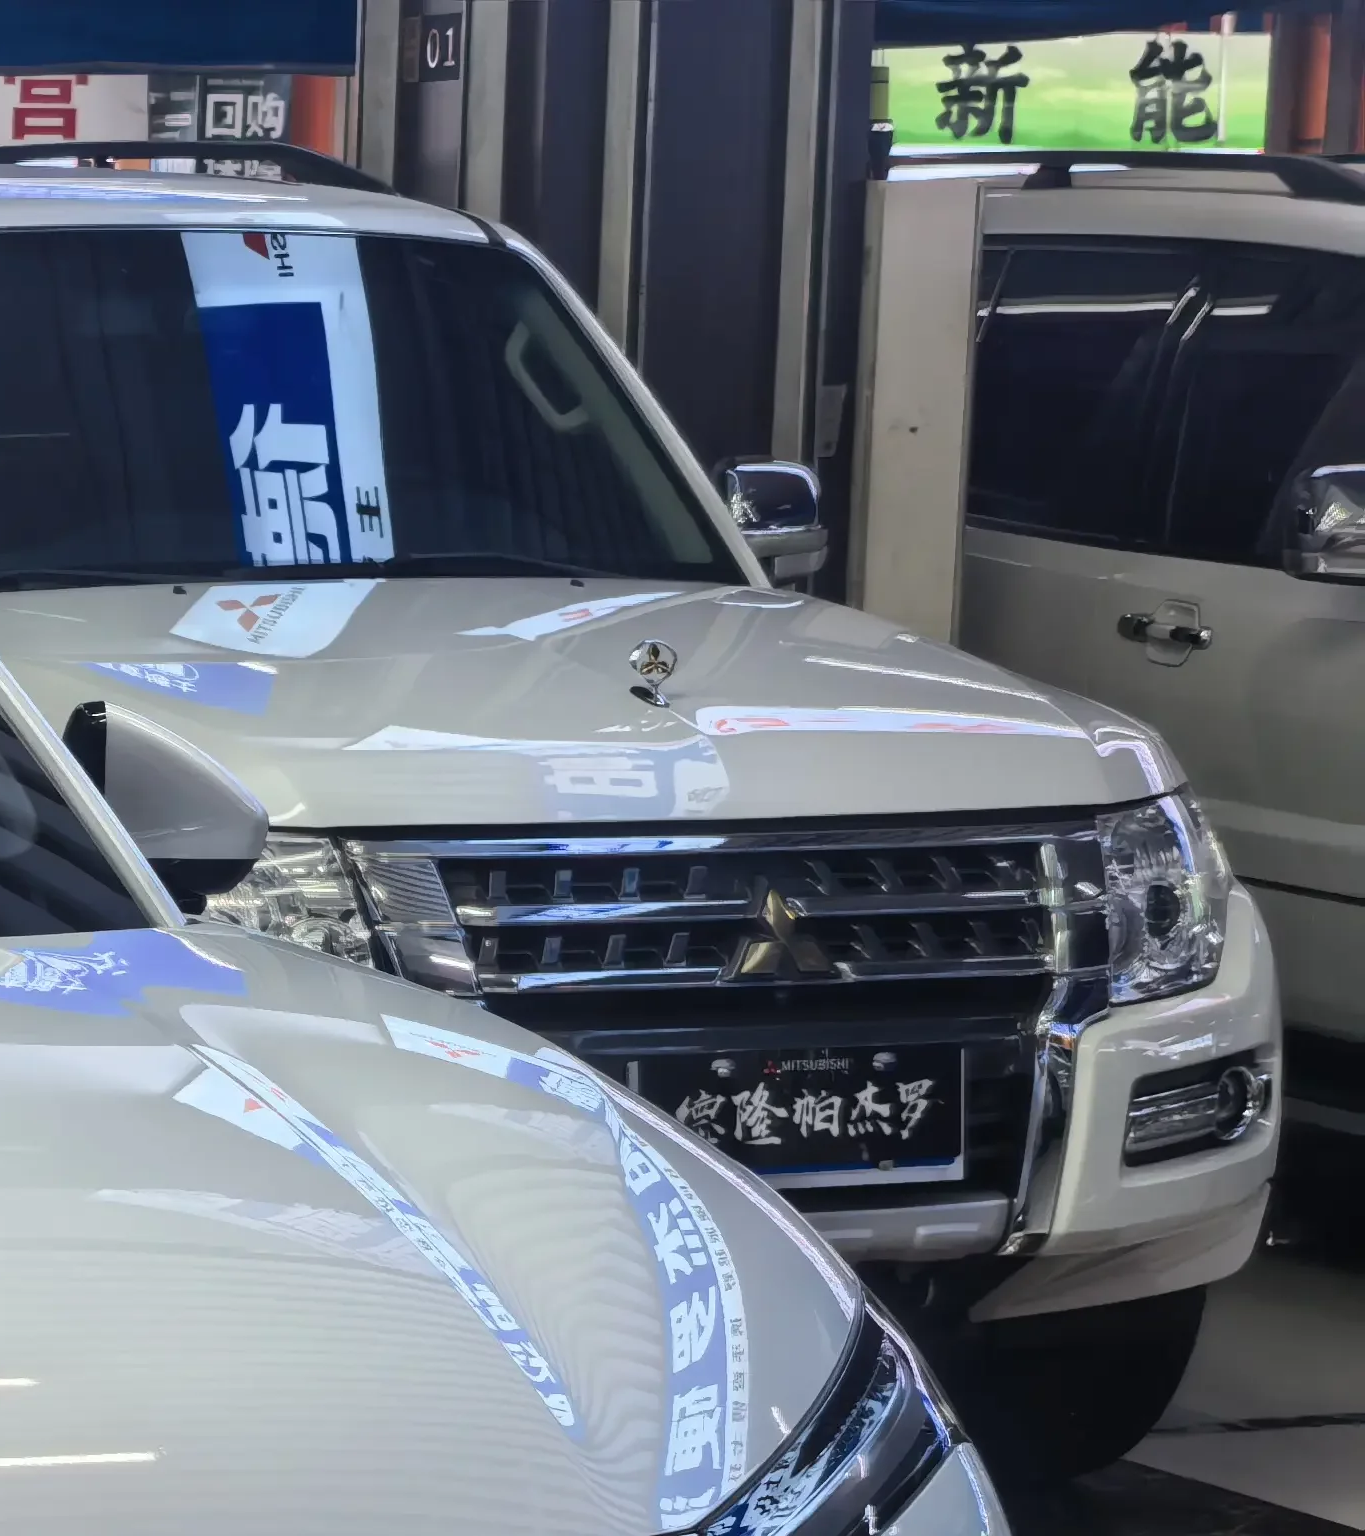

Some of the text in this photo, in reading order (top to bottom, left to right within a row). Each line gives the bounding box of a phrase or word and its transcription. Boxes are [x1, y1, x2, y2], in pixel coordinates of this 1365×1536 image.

[426, 27, 456, 69] 01
[935, 38, 1218, 144] 新能
[204, 93, 285, 139] 回购
[782, 1057, 850, 1073] MITSUBISHI
[675, 1078, 936, 1146] 德隆帕杰罗
